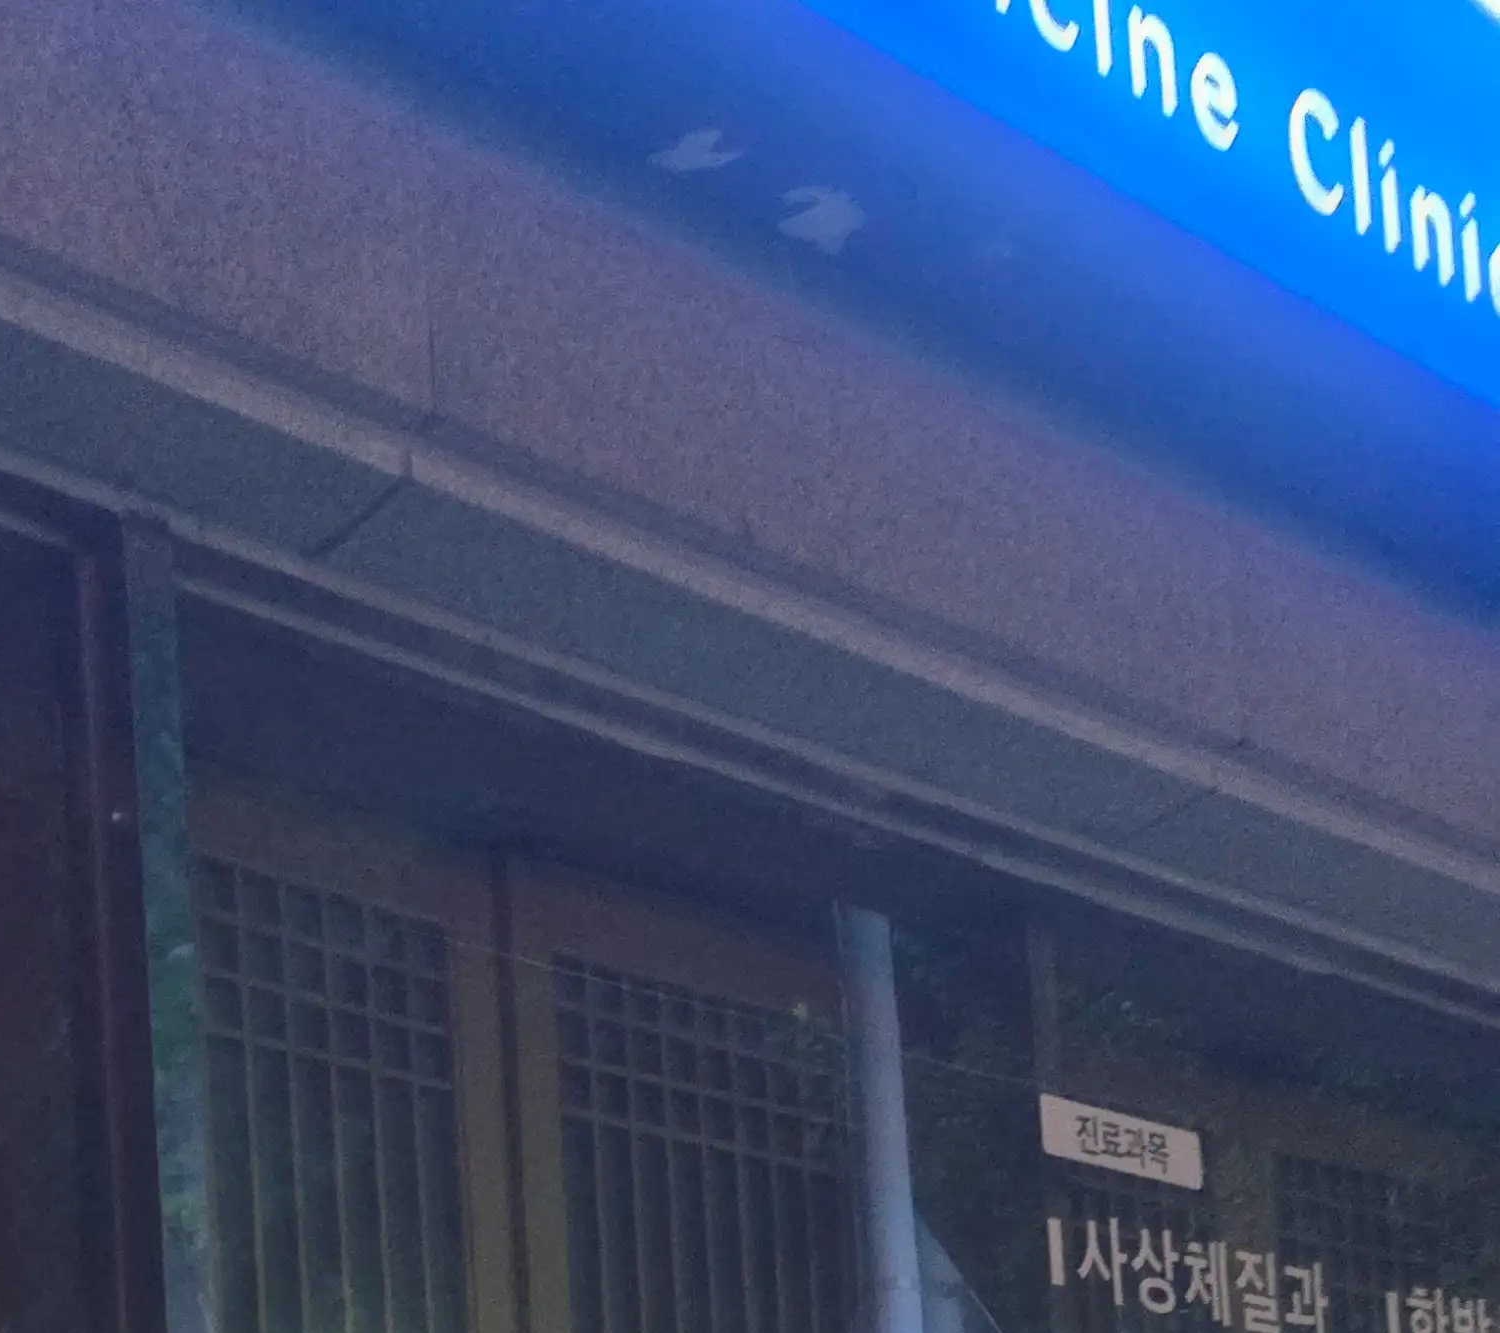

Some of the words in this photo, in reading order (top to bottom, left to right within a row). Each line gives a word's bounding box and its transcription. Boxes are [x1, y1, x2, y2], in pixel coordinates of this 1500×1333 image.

[995, 0, 1239, 151] cine
[1289, 88, 1500, 318] Clini
[1074, 1113, 1171, 1175] 진료과목
